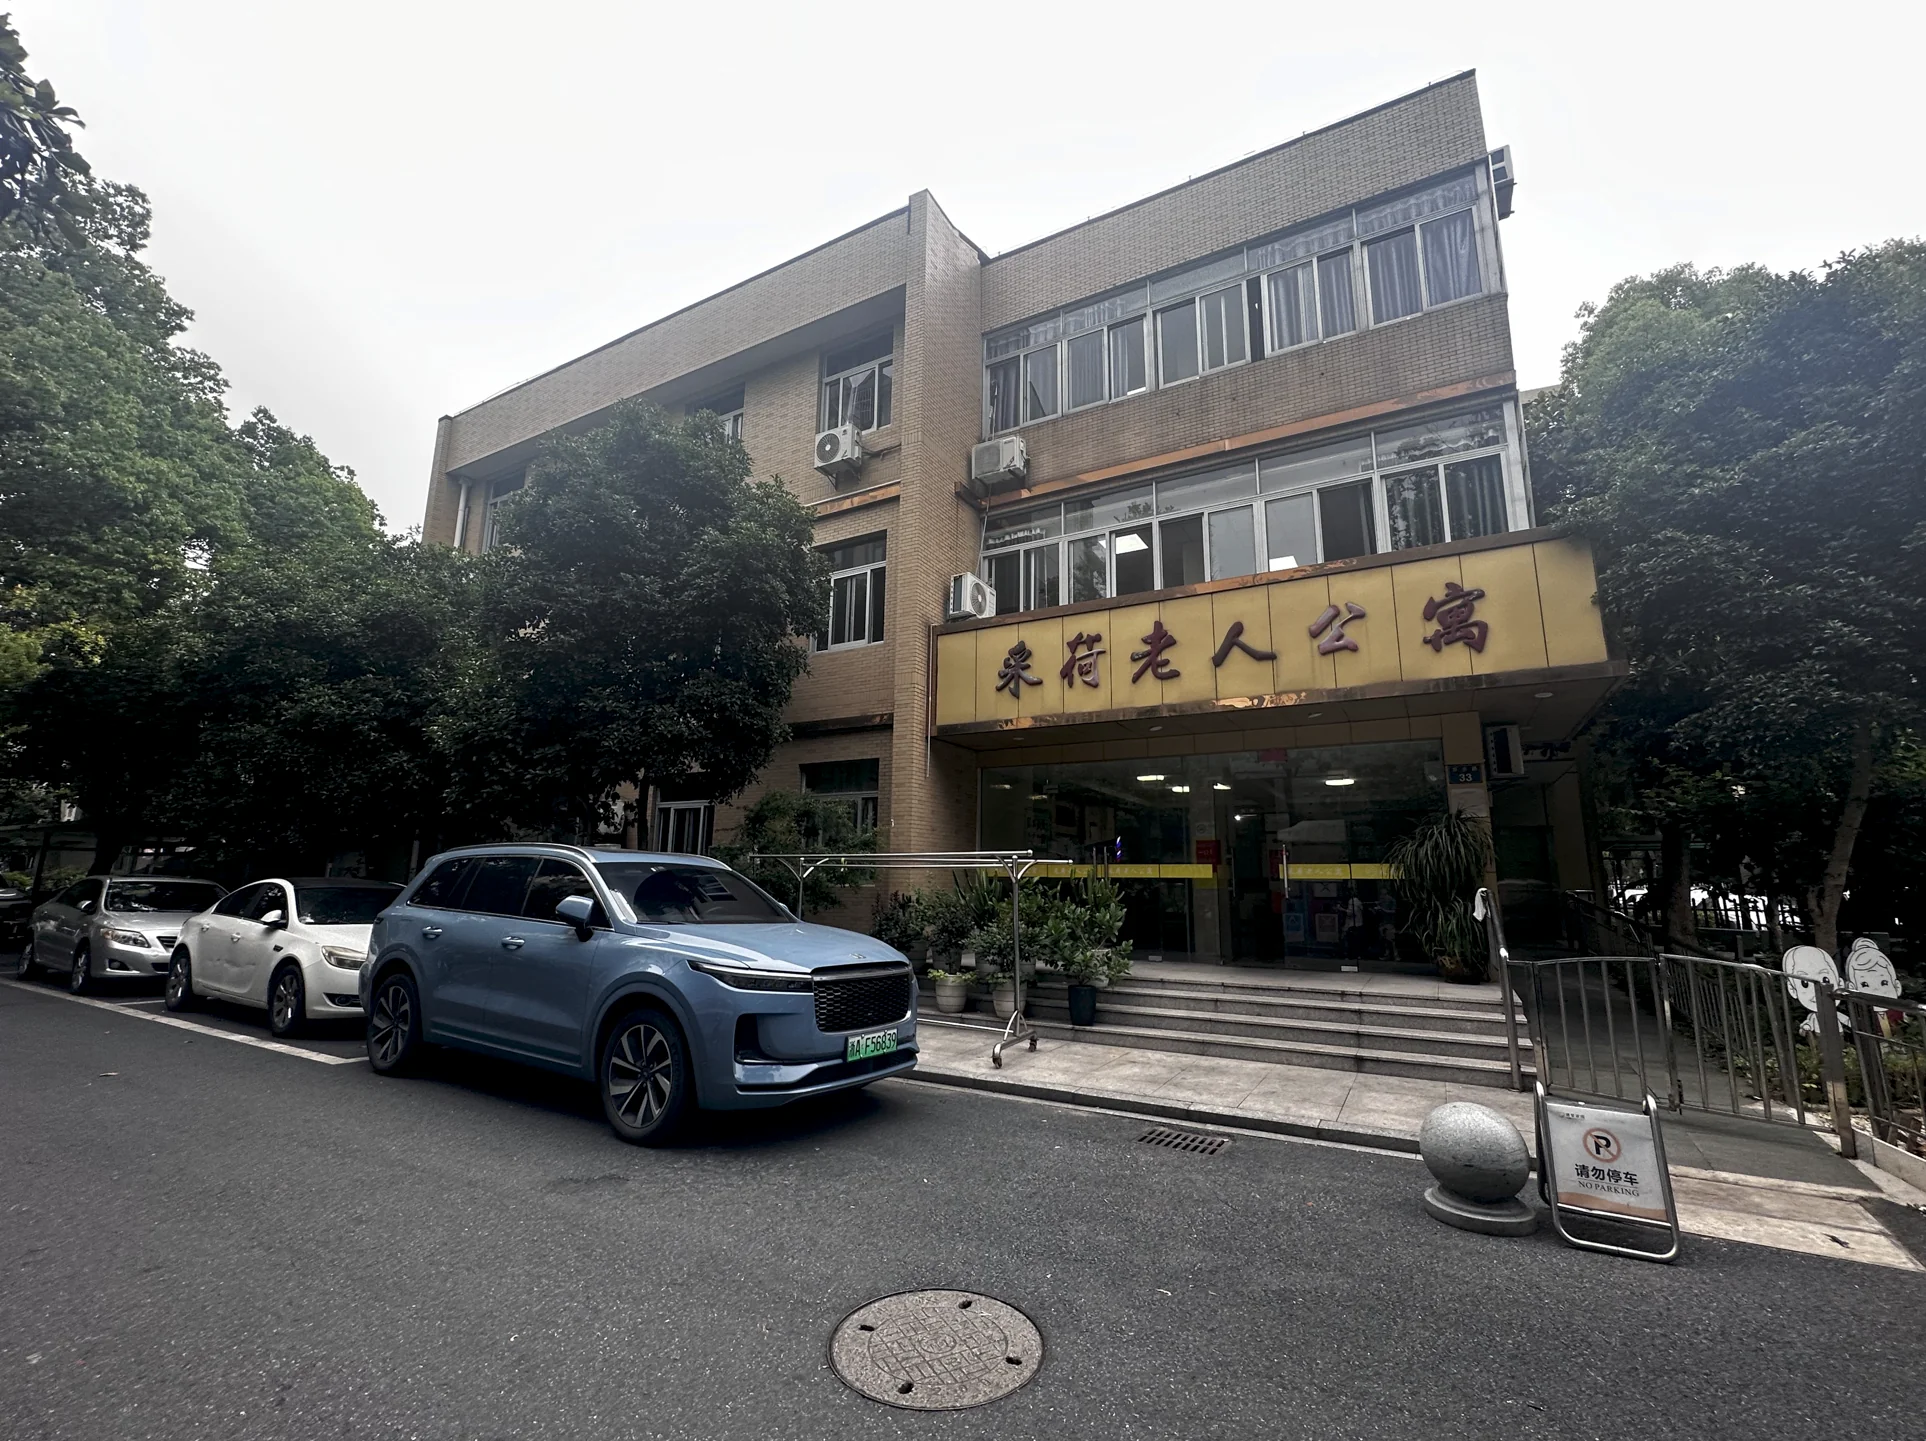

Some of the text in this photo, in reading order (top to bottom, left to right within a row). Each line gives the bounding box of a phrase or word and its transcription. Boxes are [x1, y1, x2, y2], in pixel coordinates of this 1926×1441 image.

[995, 582, 1488, 699] 采荷老人公寓
[1459, 773, 1473, 782] 33
[1574, 1163, 1639, 1186] 请勿停车
[1578, 1180, 1639, 1197] NO PARKING
